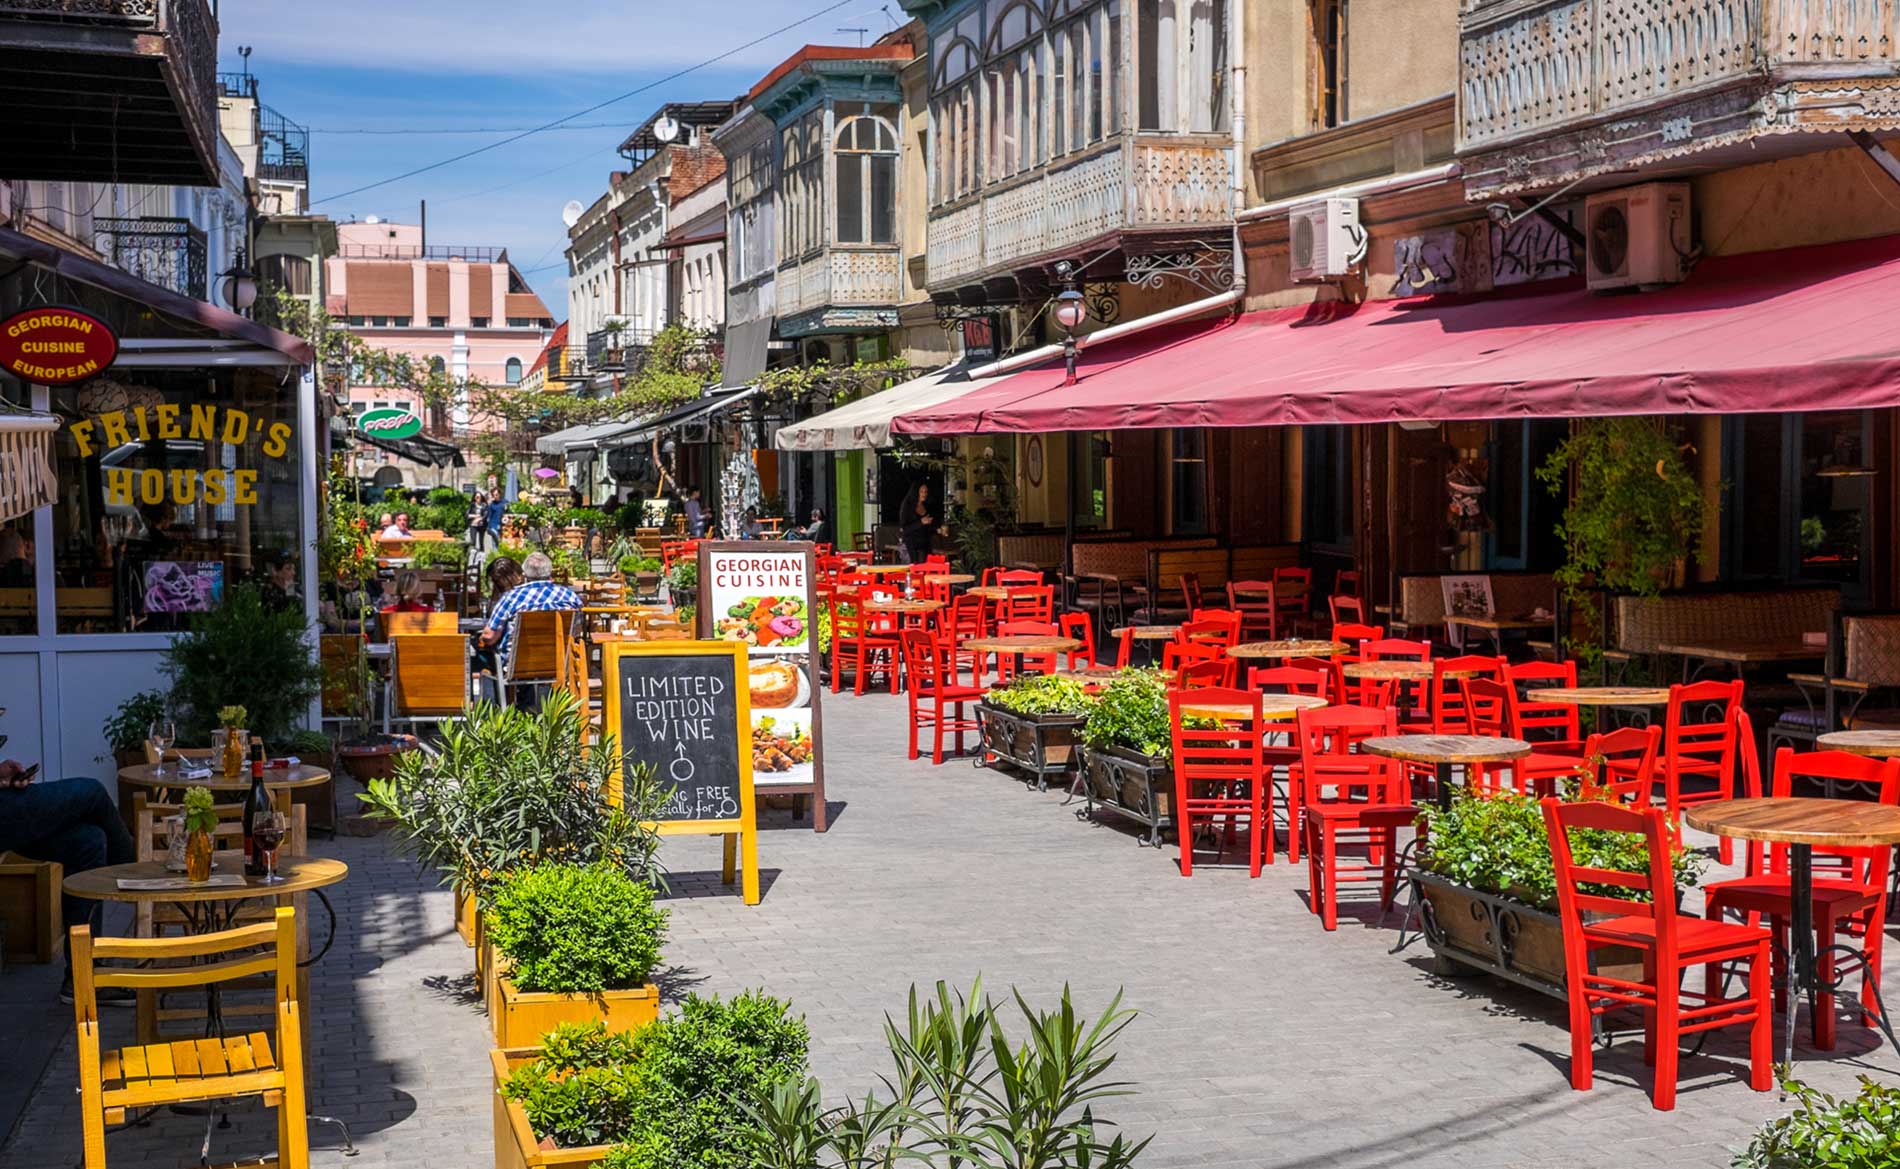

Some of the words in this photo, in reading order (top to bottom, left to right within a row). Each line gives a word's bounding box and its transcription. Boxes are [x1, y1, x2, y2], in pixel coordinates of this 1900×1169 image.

[7, 316, 93, 337] GEORGIAN
[21, 341, 85, 354] CUISINE
[12, 359, 98, 379] EUROPEAN
[69, 404, 292, 458] FRIEND'S
[108, 469, 257, 505] HOUSE
[197, 561, 215, 569] LIVE
[716, 558, 802, 572] GEORGIAN
[716, 574, 803, 588] CUISINE
[627, 676, 724, 698] LIMITED
[636, 697, 715, 721] EDITION
[646, 718, 714, 742] WINE
[696, 786, 731, 800] FREE
[696, 800, 715, 819] for
